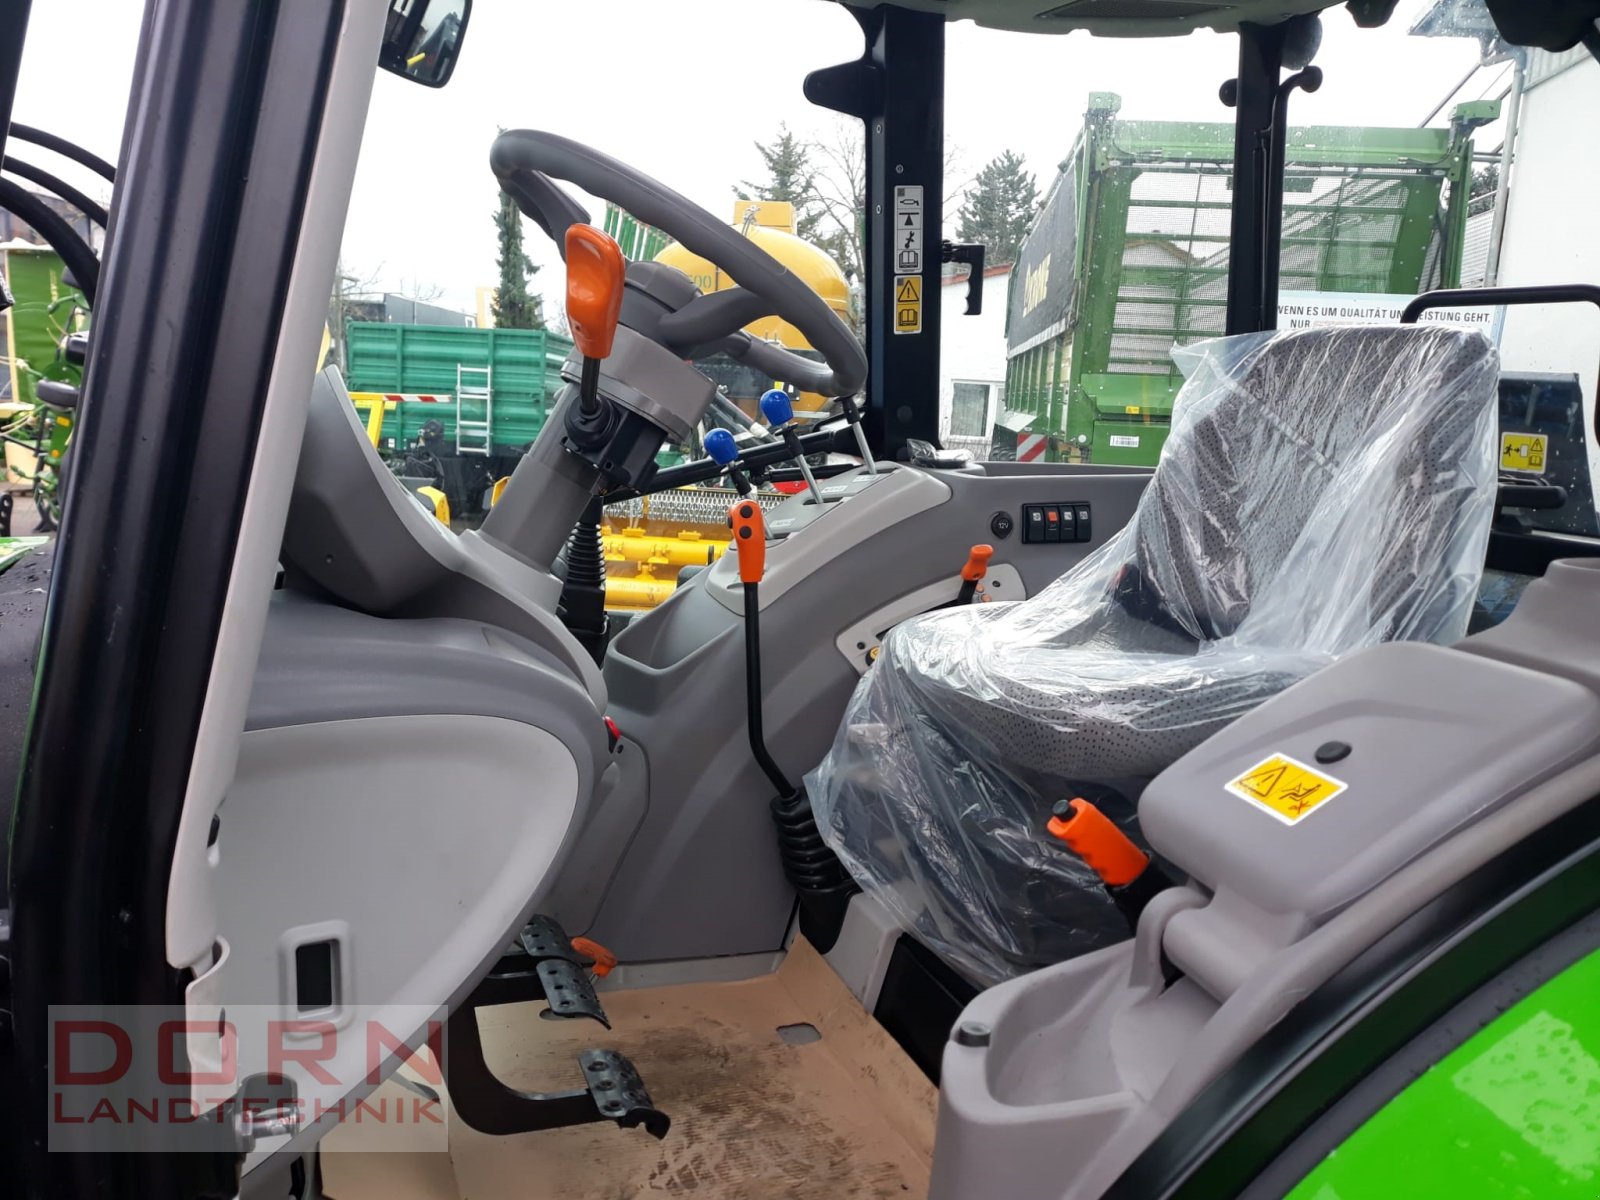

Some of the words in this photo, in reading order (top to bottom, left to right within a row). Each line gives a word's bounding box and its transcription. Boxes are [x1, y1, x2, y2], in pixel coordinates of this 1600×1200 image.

[1306, 306, 1319, 316] ES
[1321, 307, 1338, 317] UM
[1340, 307, 1388, 319] QUALITÄT
[1389, 309, 1405, 319] UN
[1419, 311, 1461, 322] EISTUNG
[1290, 319, 1311, 329] NUR
